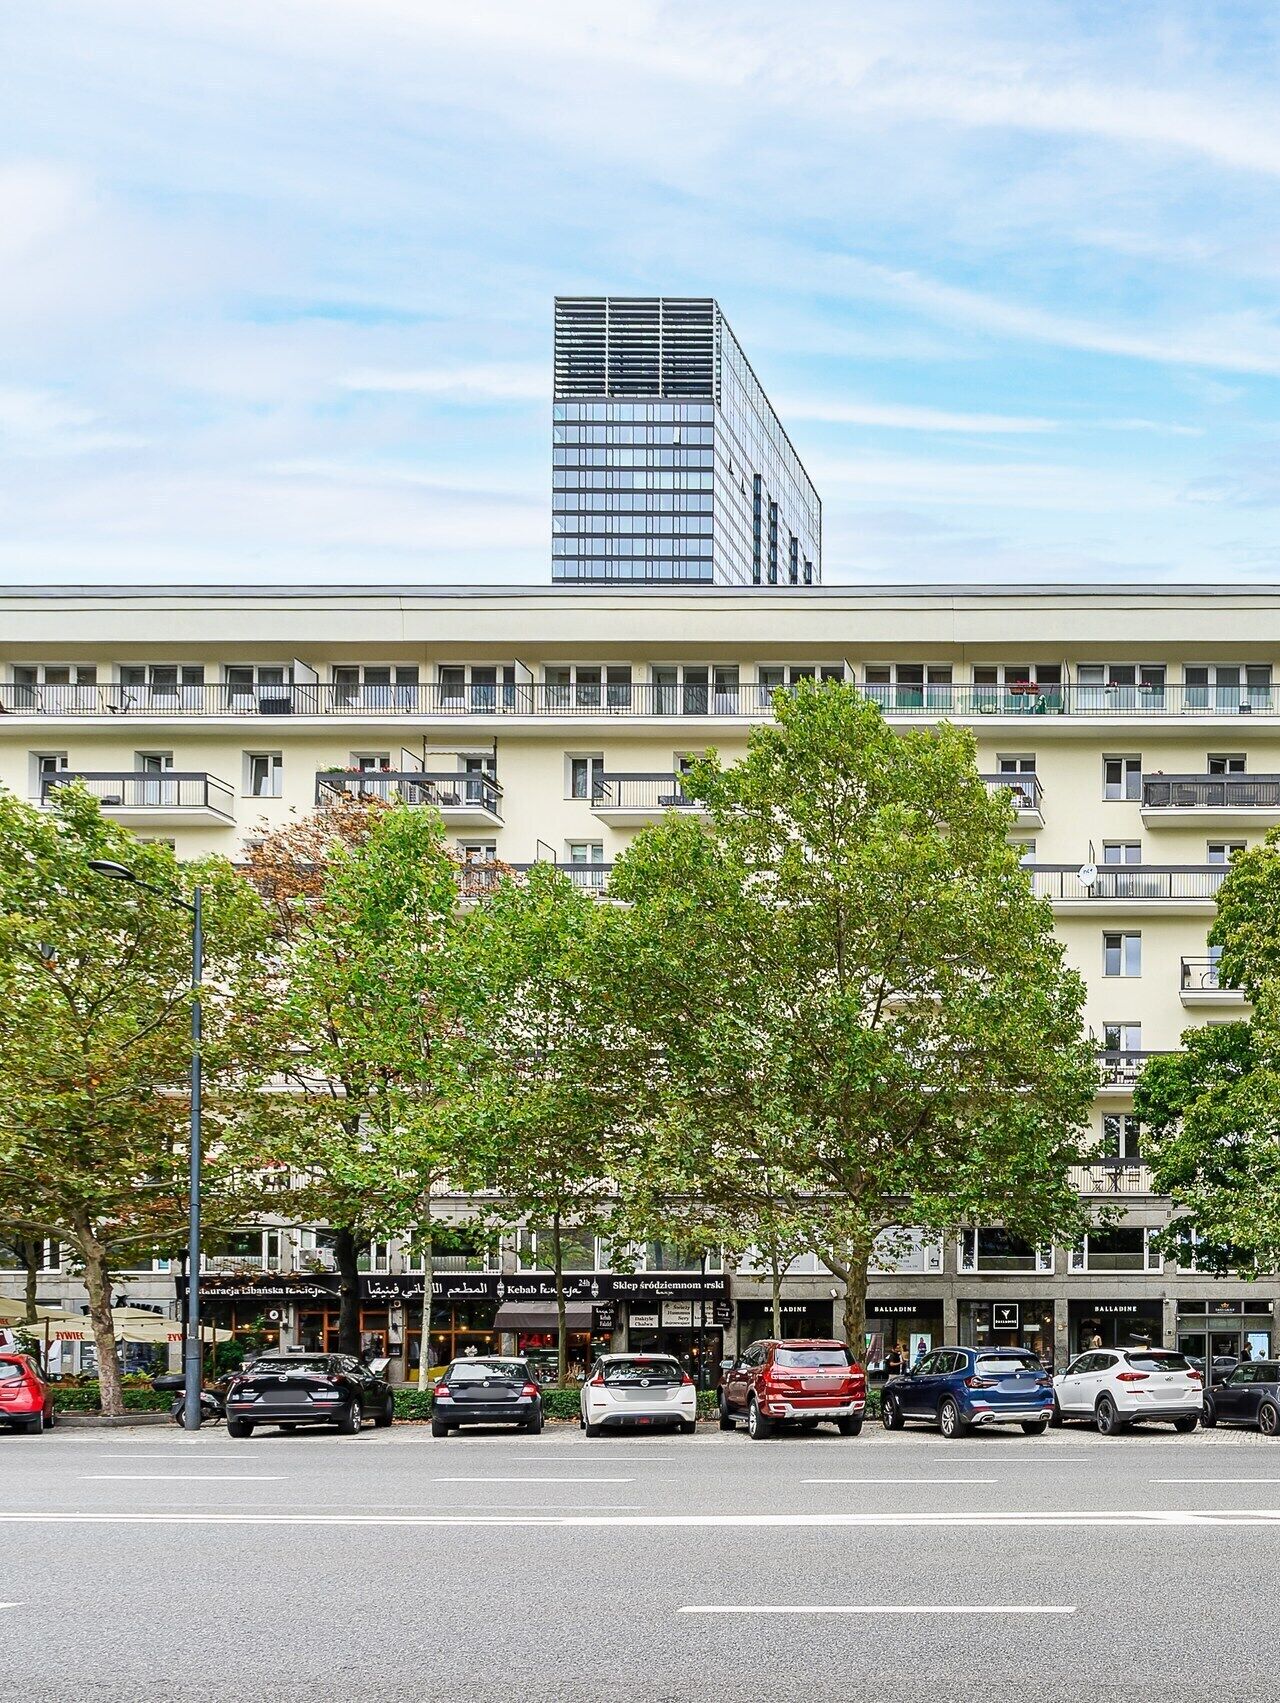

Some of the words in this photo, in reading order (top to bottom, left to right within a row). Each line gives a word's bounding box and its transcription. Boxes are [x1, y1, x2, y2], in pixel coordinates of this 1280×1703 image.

[185, 1285, 239, 1297] Rtauracja
[366, 1280, 400, 1299] فينيقيا
[447, 1282, 488, 1298] المطعم
[507, 1285, 537, 1294] Kebab
[540, 1283, 582, 1298] Fencja
[612, 1281, 638, 1291] Sklep
[55, 1331, 85, 1341] ŻYWIEC
